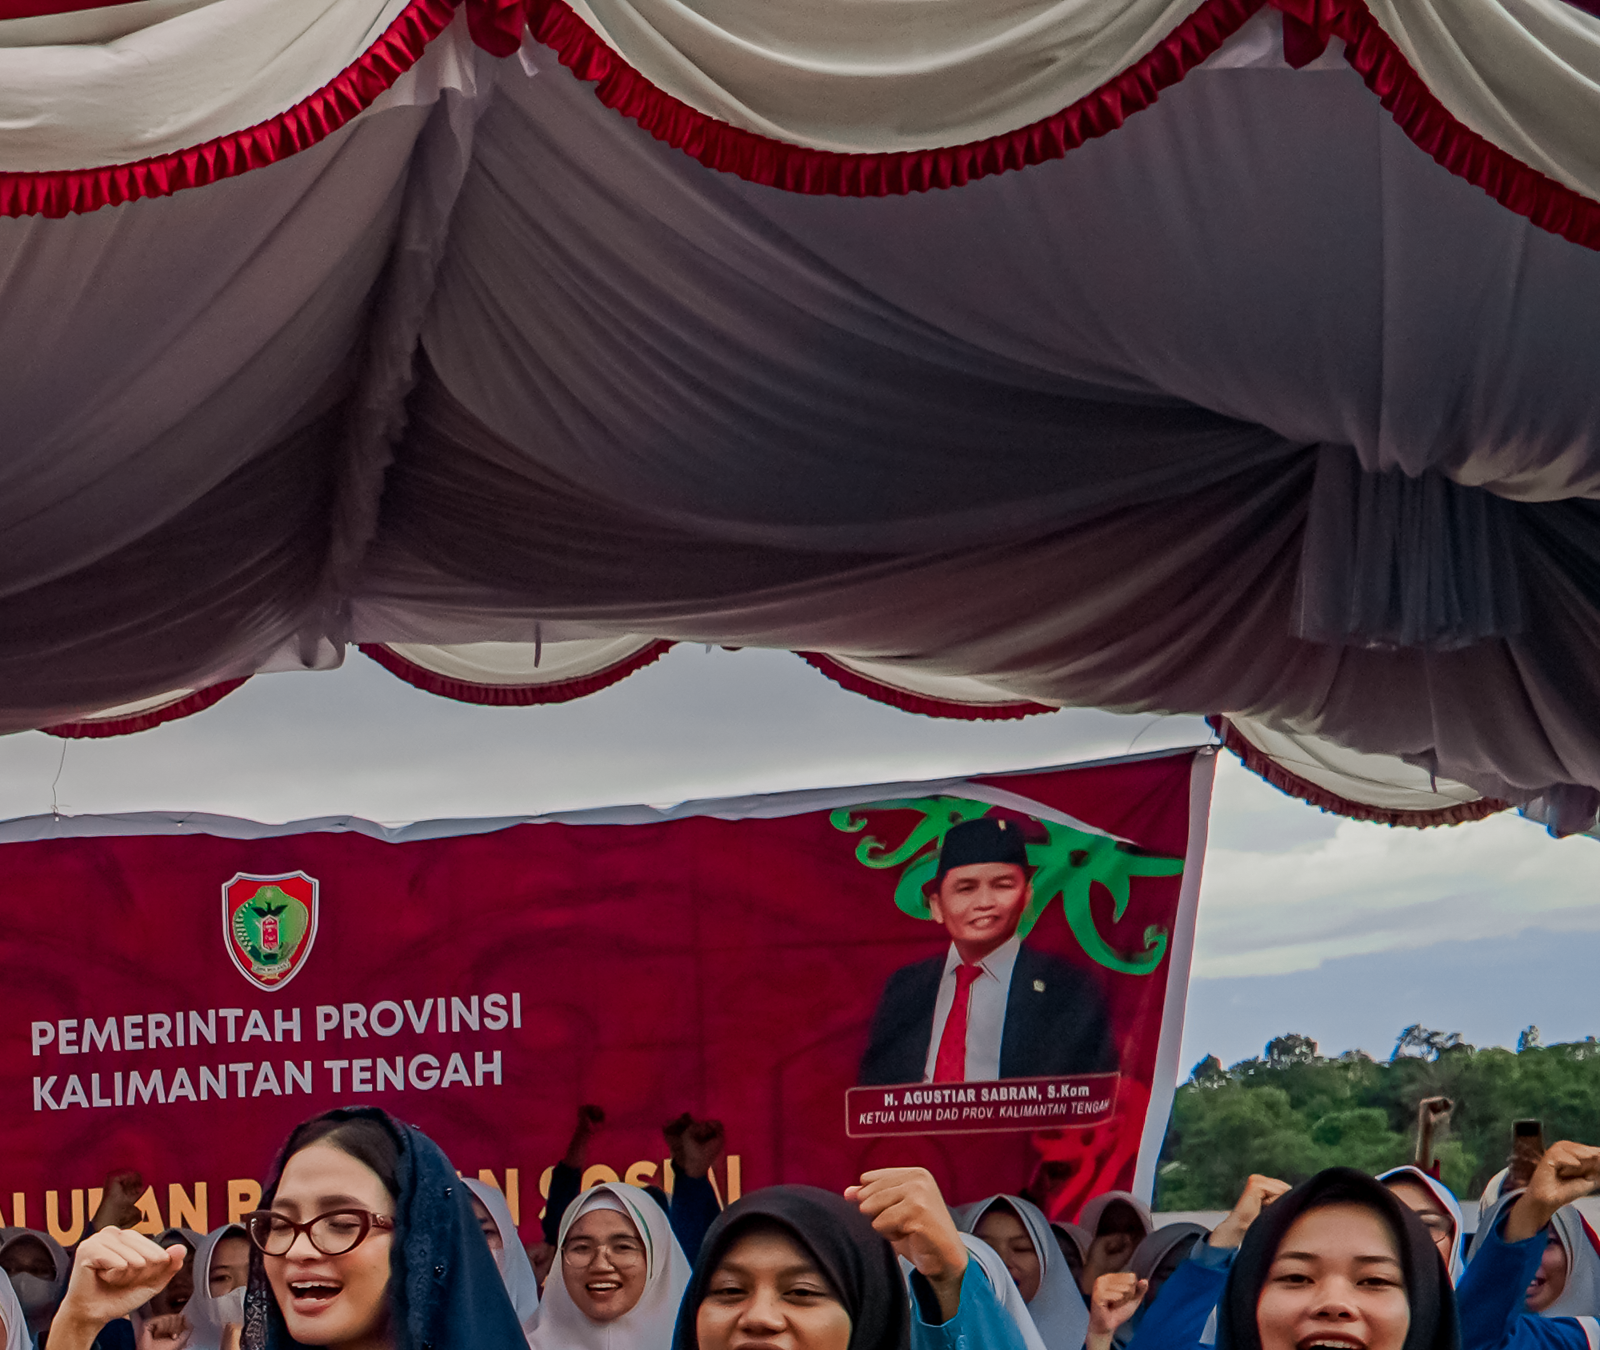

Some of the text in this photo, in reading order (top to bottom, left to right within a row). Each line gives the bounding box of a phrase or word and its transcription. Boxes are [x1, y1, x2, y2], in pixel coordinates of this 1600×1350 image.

[31, 992, 522, 1056] PEMERINTAH PROVINSI
[33, 1050, 502, 1111] KALIMANTAN TENGAH
[884, 1083, 1090, 1106] H. AGUSTIAR SABRAN, S.Kom
[859, 1098, 1110, 1125] KETUA UMUM DAD PROV. KALIMANTAN TENGAH
